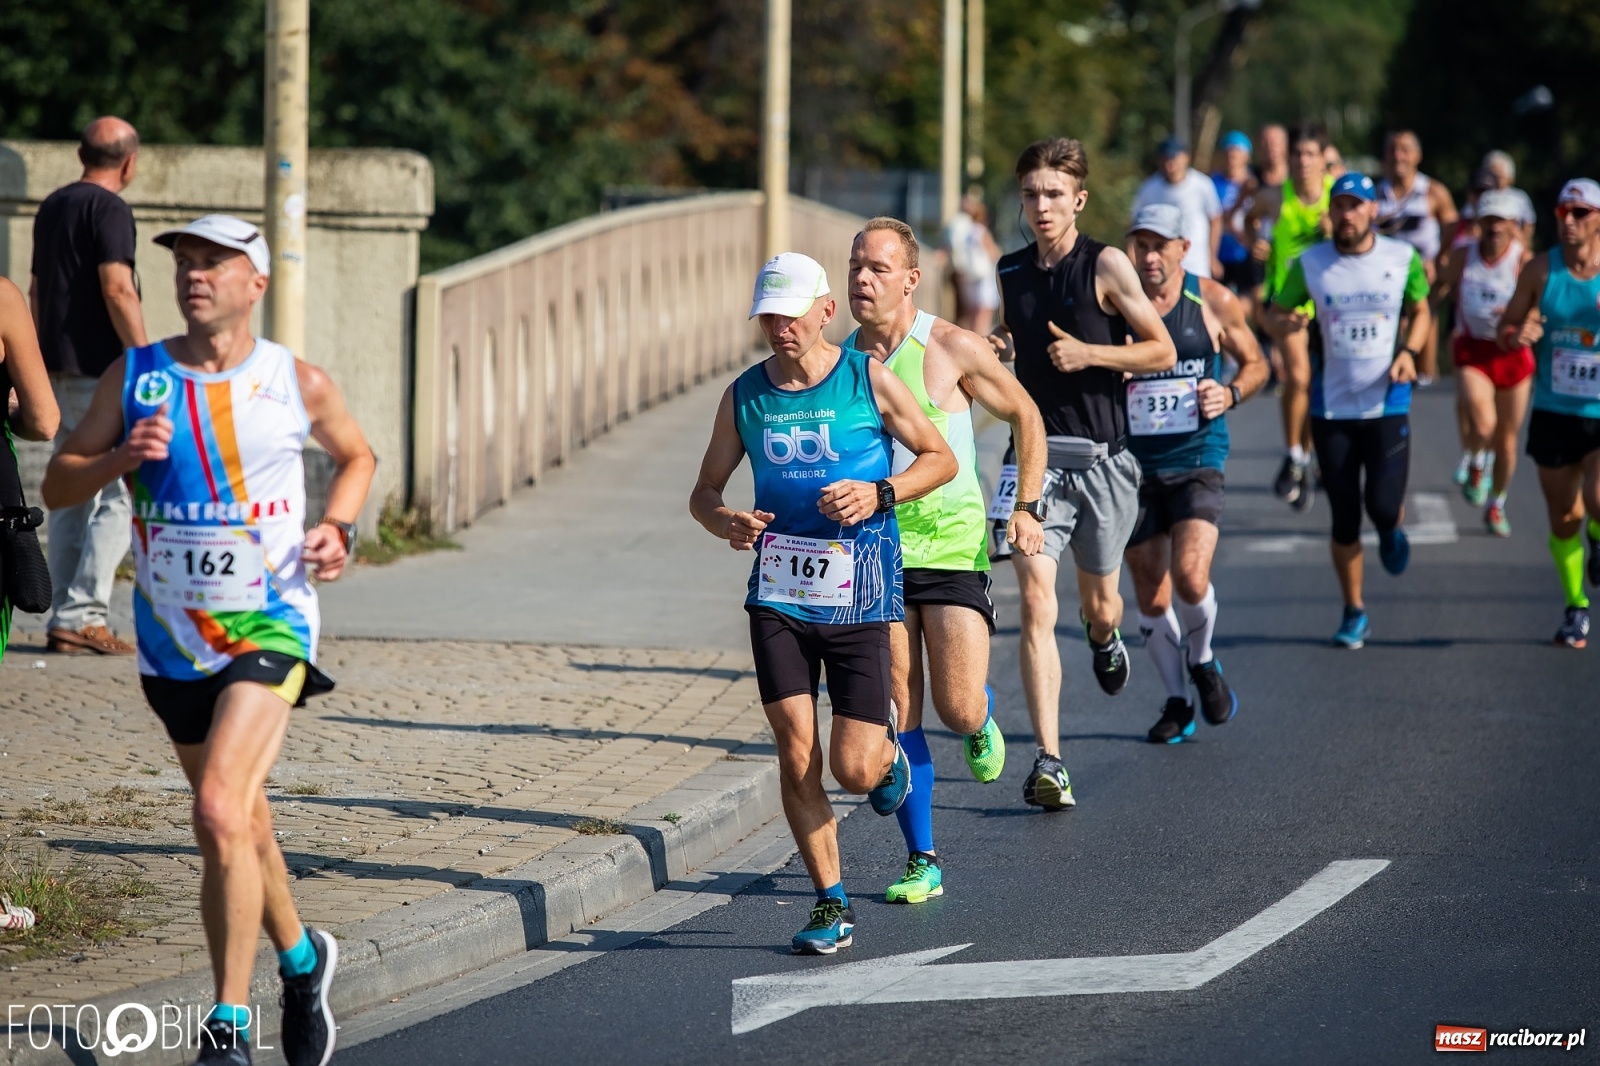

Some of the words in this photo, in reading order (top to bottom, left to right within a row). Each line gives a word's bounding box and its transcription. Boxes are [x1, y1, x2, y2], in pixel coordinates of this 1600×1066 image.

[1148, 395, 1179, 412] 337
[764, 408, 836, 423] BiegamBoLubię
[763, 423, 840, 465] bbl
[781, 468, 827, 479] RACIBÓRZ
[998, 479, 1017, 497] 12
[183, 550, 235, 576] 162
[789, 554, 830, 580] 167
